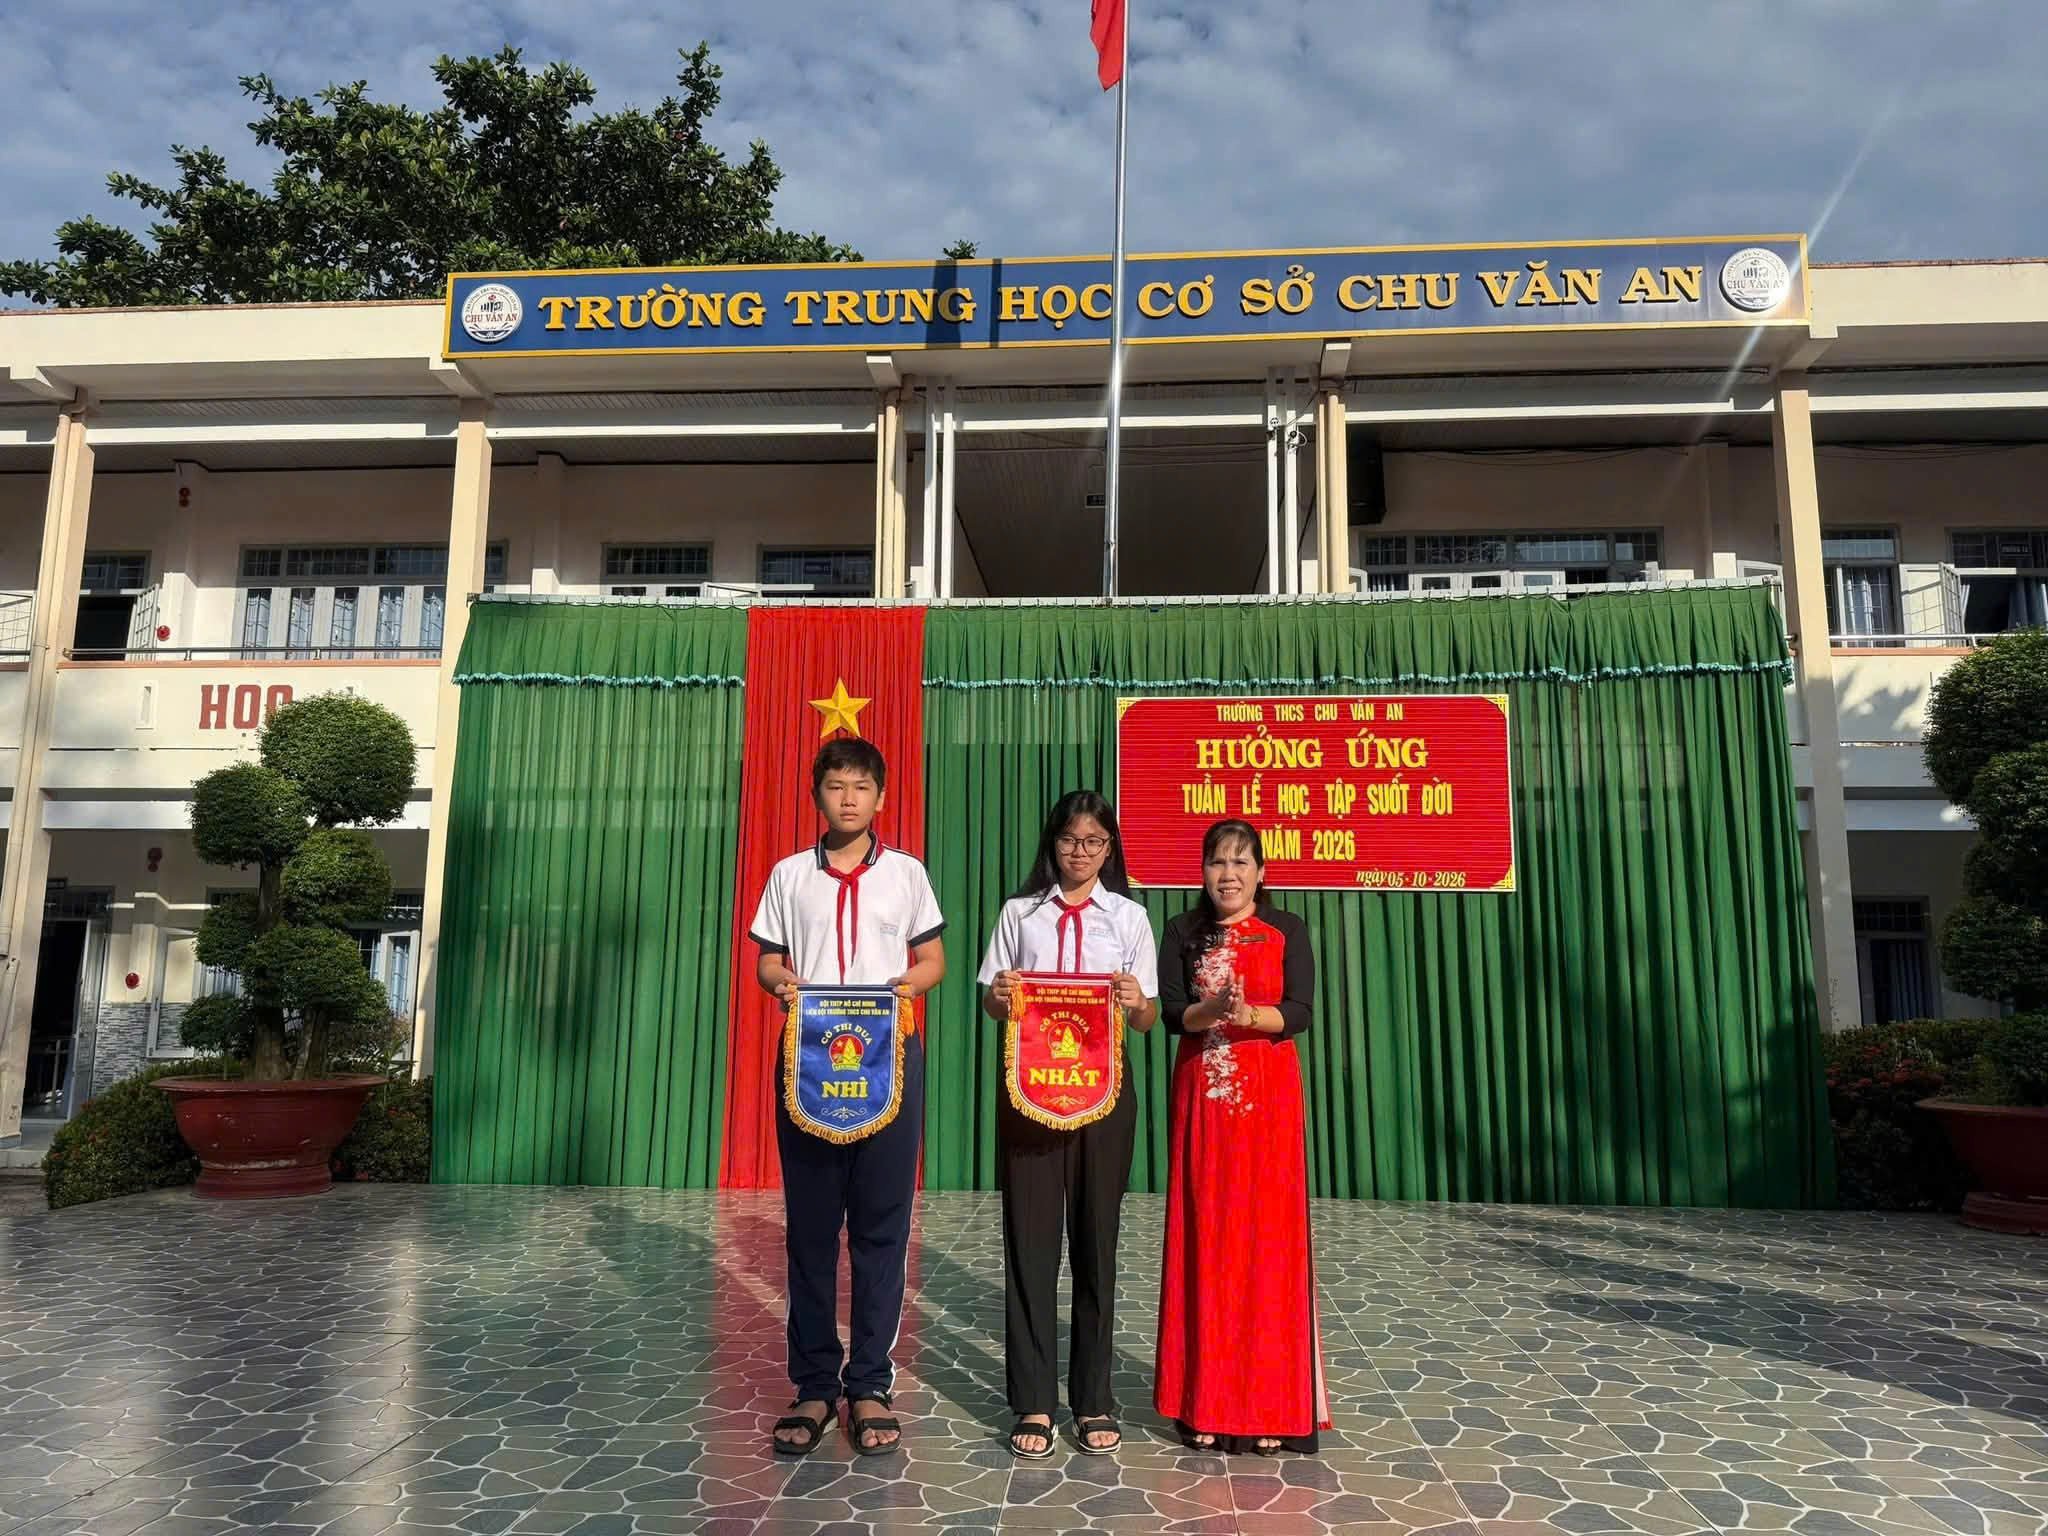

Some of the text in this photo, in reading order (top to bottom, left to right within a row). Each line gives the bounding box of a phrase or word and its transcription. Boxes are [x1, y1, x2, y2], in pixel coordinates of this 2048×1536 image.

[538, 283, 766, 330] TRƯỜNG
[785, 287, 977, 325] TRUNG
[998, 283, 1113, 329] HỌC
[1138, 274, 1215, 318] CƠ
[1241, 264, 1316, 315] SỞ
[1338, 272, 1460, 311] CHU
[1477, 260, 1602, 306] VĂN
[1620, 265, 1704, 304] AN
[465, 314, 482, 324] CHU
[1274, 704, 1304, 722] THCS
[1314, 703, 1338, 722] CHU
[1350, 699, 1375, 721] VĂN
[1386, 703, 1404, 721] AN
[1196, 724, 1429, 769] HƯỞNG ỨNG
[1182, 772, 1453, 820] TUẦN LỄ HỌC TẬP SUỐT ĐỜI
[1261, 823, 1356, 861] NĂM 2026
[1355, 867, 1387, 888] ngày
[1051, 1011, 1069, 1020] THI
[833, 1023, 852, 1032] THI
[1029, 1062, 1100, 1087] NHẤT
[822, 1076, 868, 1098] NHÌ
